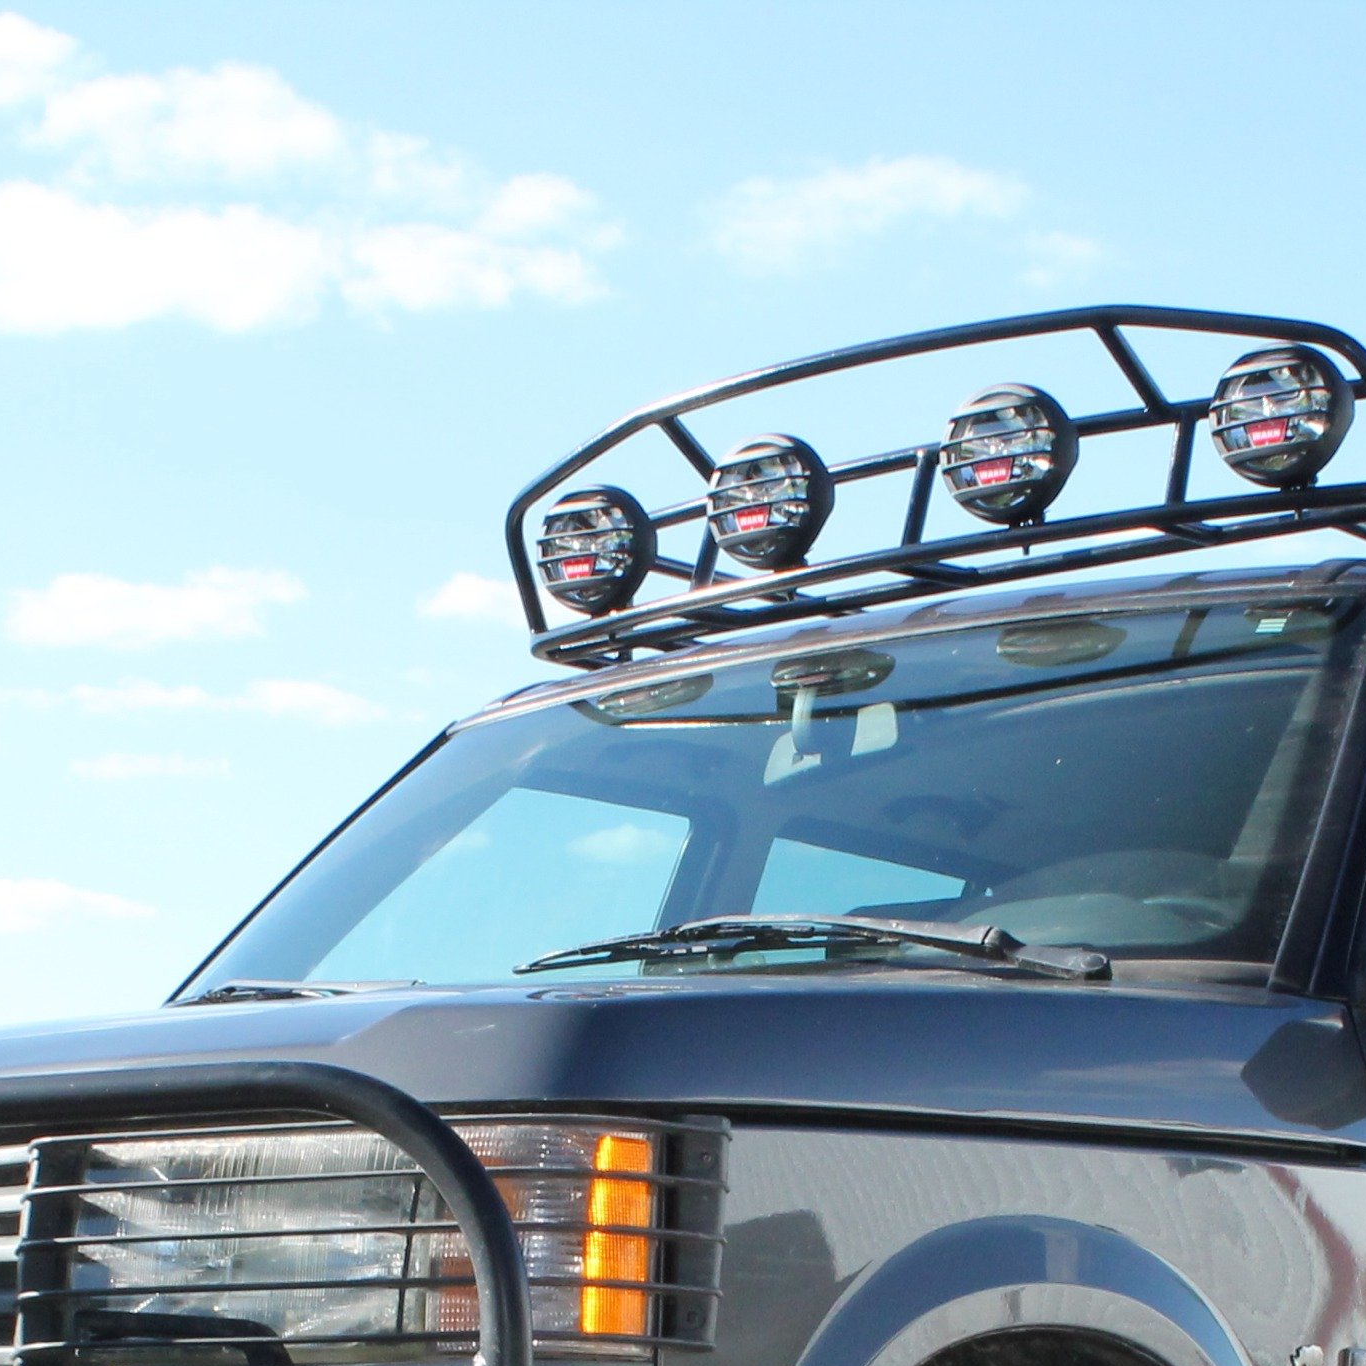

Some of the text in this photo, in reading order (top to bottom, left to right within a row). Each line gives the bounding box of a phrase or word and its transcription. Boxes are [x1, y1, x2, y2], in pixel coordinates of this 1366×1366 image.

[1251, 428, 1281, 441] WARN
[978, 467, 1007, 480] WARN
[739, 514, 765, 527] WARN
